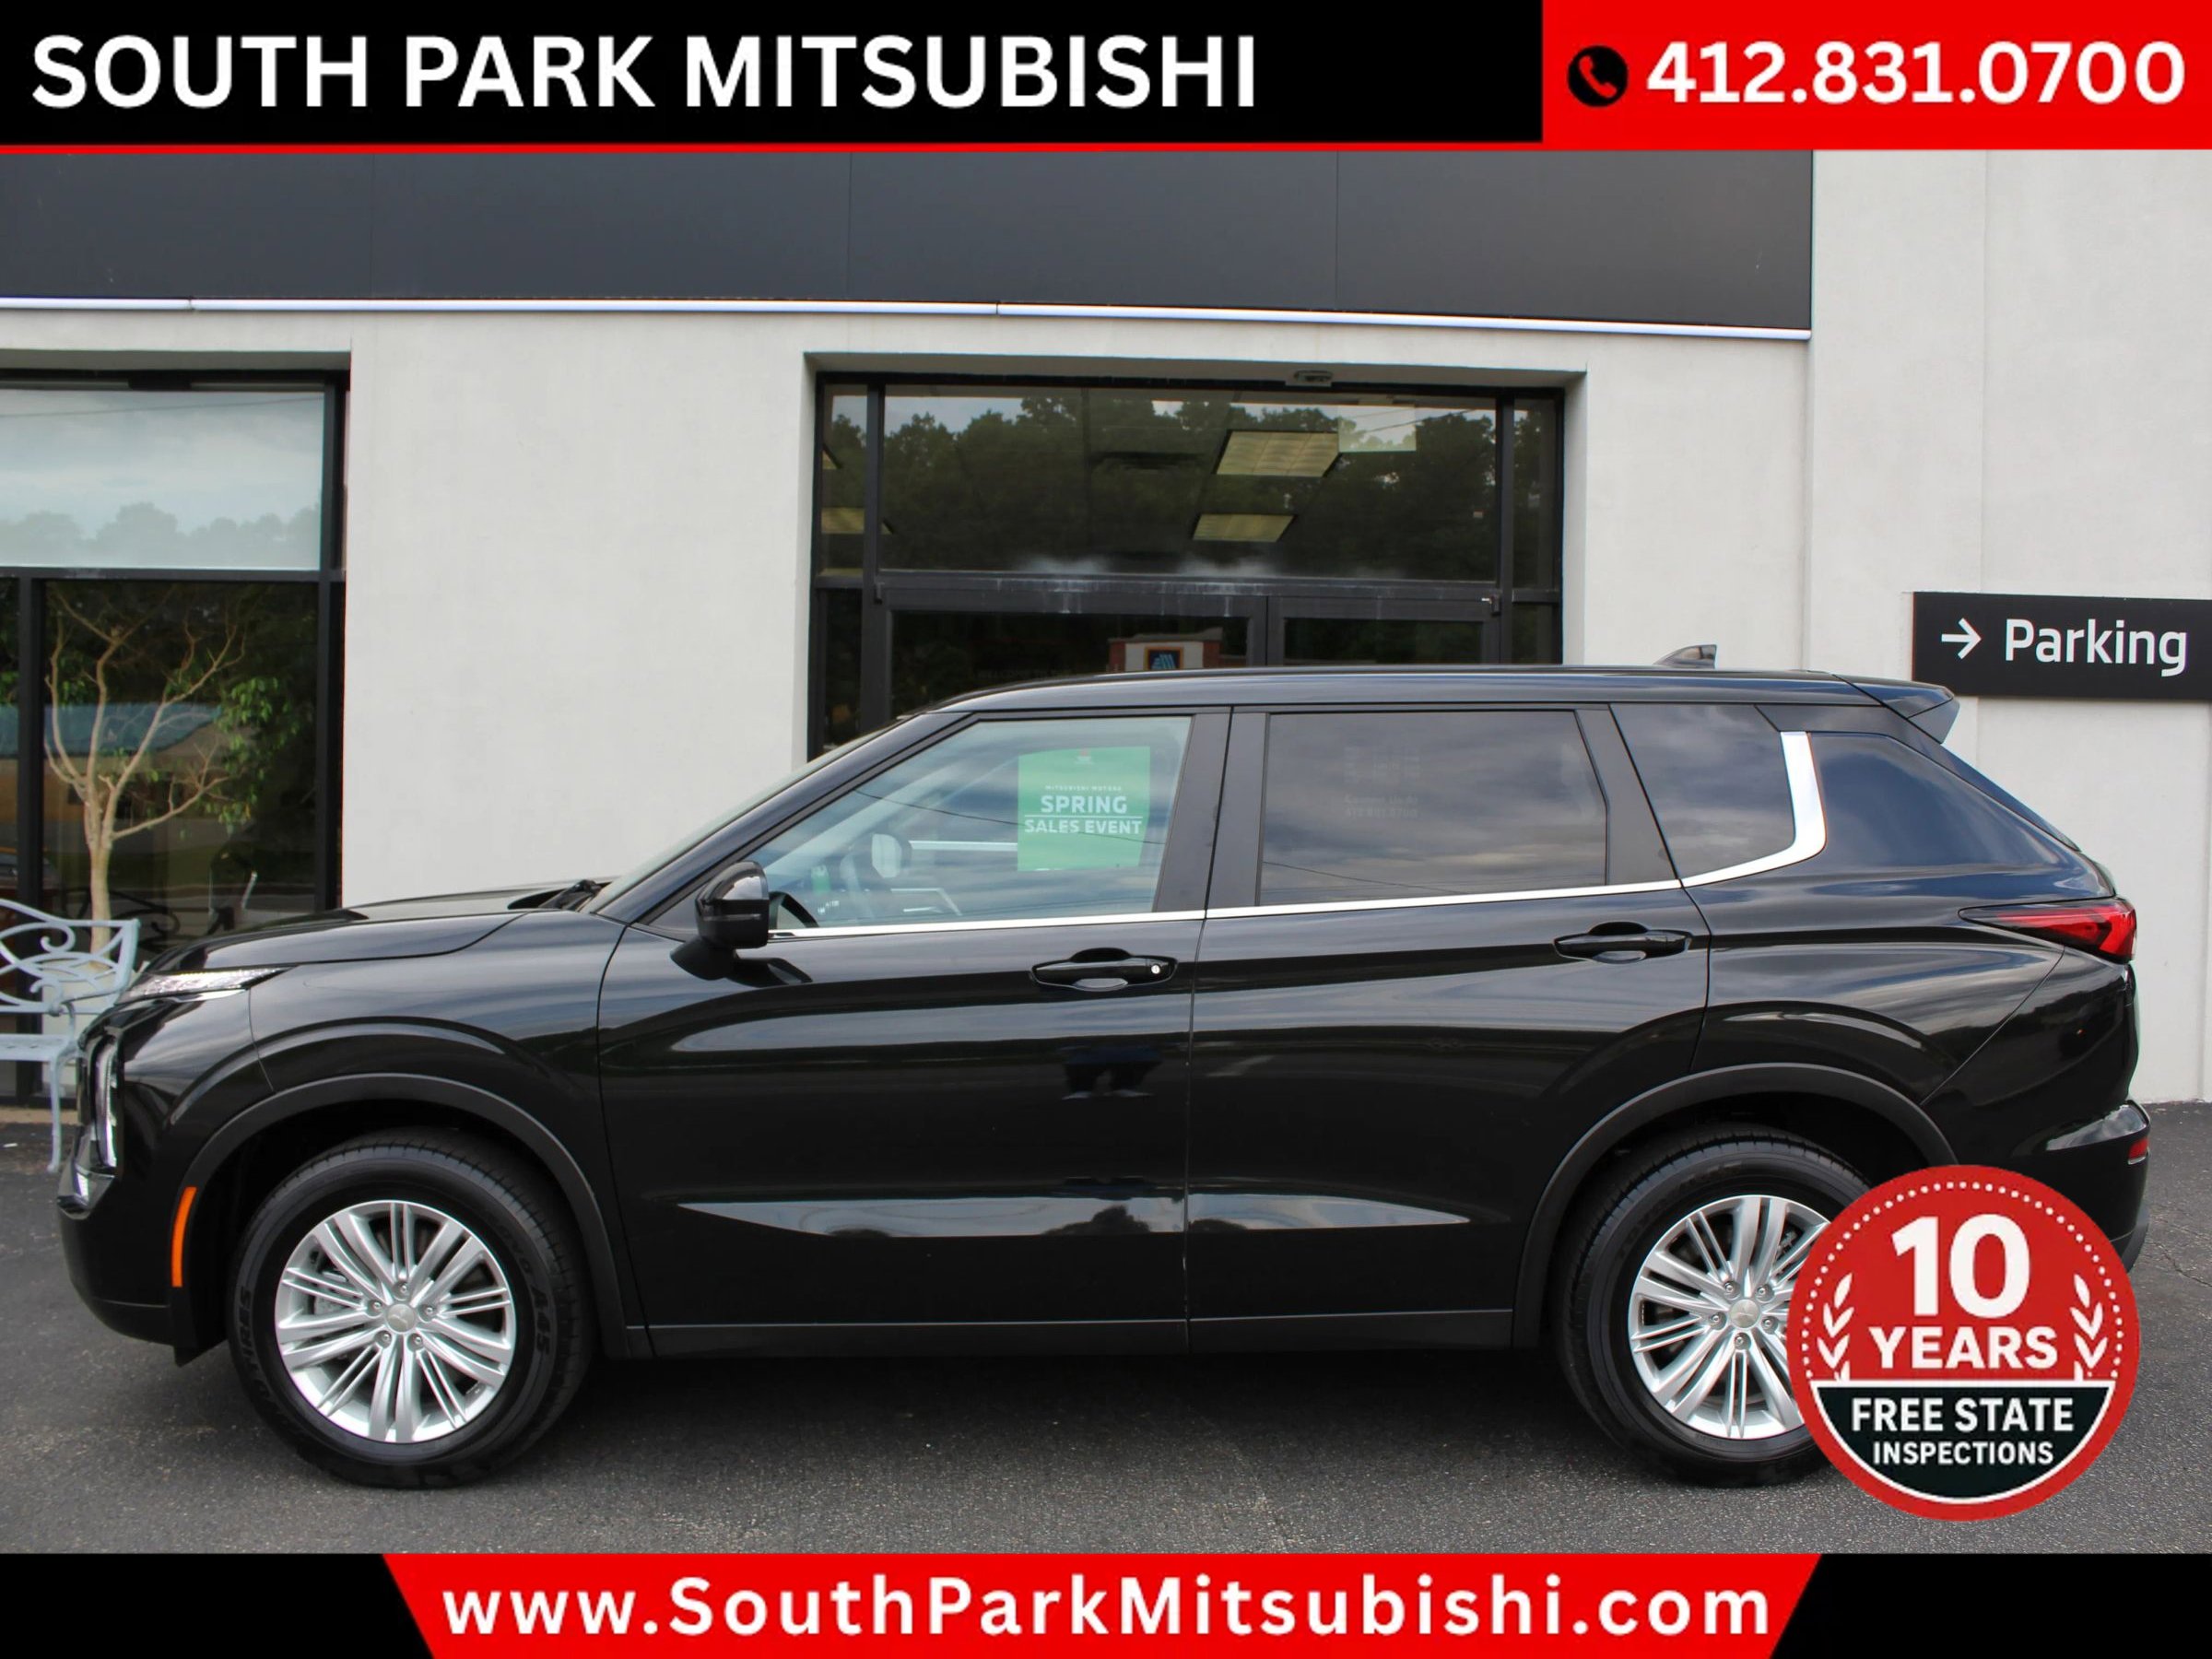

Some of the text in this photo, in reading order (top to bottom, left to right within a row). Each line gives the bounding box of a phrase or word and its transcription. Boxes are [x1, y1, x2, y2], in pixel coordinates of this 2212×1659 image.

[2005, 618, 2189, 677] Parking
[1040, 794, 1128, 814] SPRING
[1024, 818, 1143, 835] SALES EVENT
